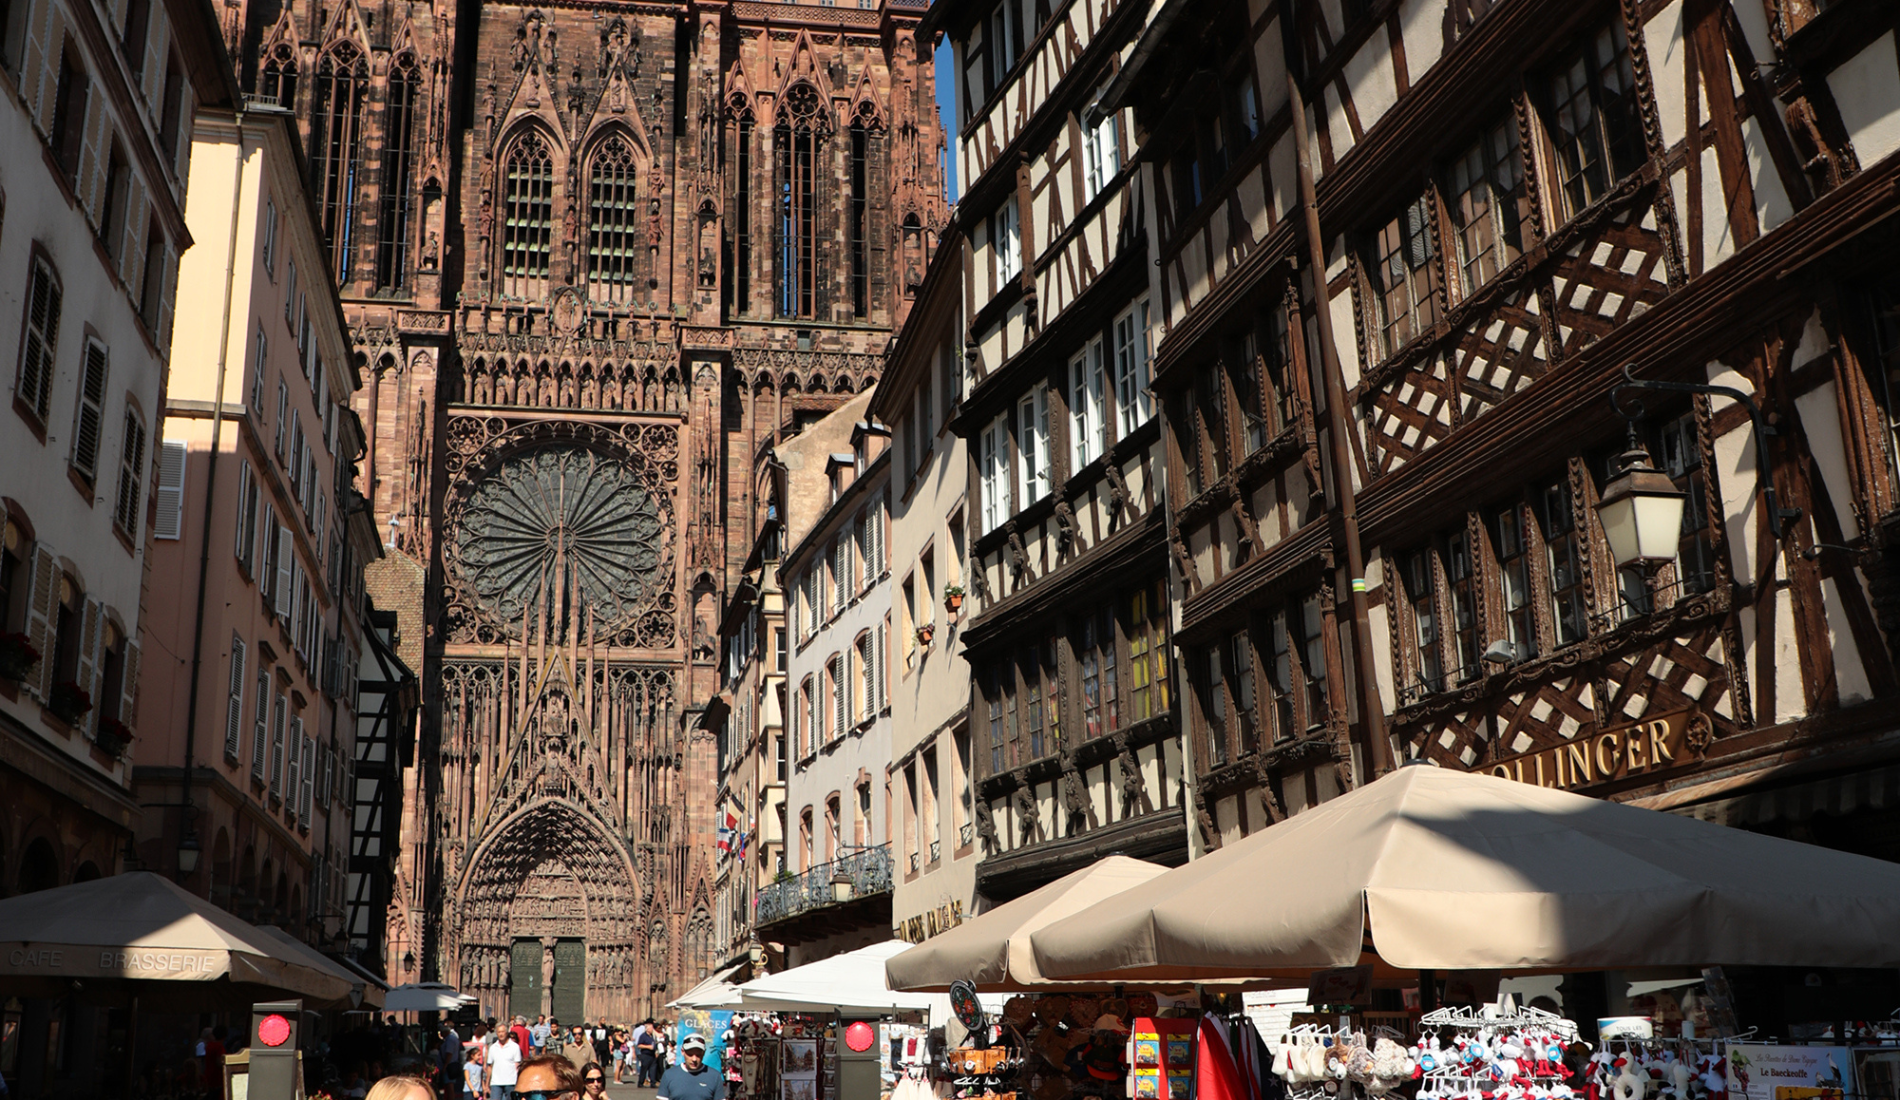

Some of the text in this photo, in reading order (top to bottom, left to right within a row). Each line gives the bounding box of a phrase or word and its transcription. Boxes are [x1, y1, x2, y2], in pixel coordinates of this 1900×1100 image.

[1478, 719, 1675, 788] LINGER
[9, 949, 216, 972] CAFE BRASSERIE
[685, 1019, 727, 1029] GLACES
[1760, 1067, 1808, 1078] Le Baeckeoffe
